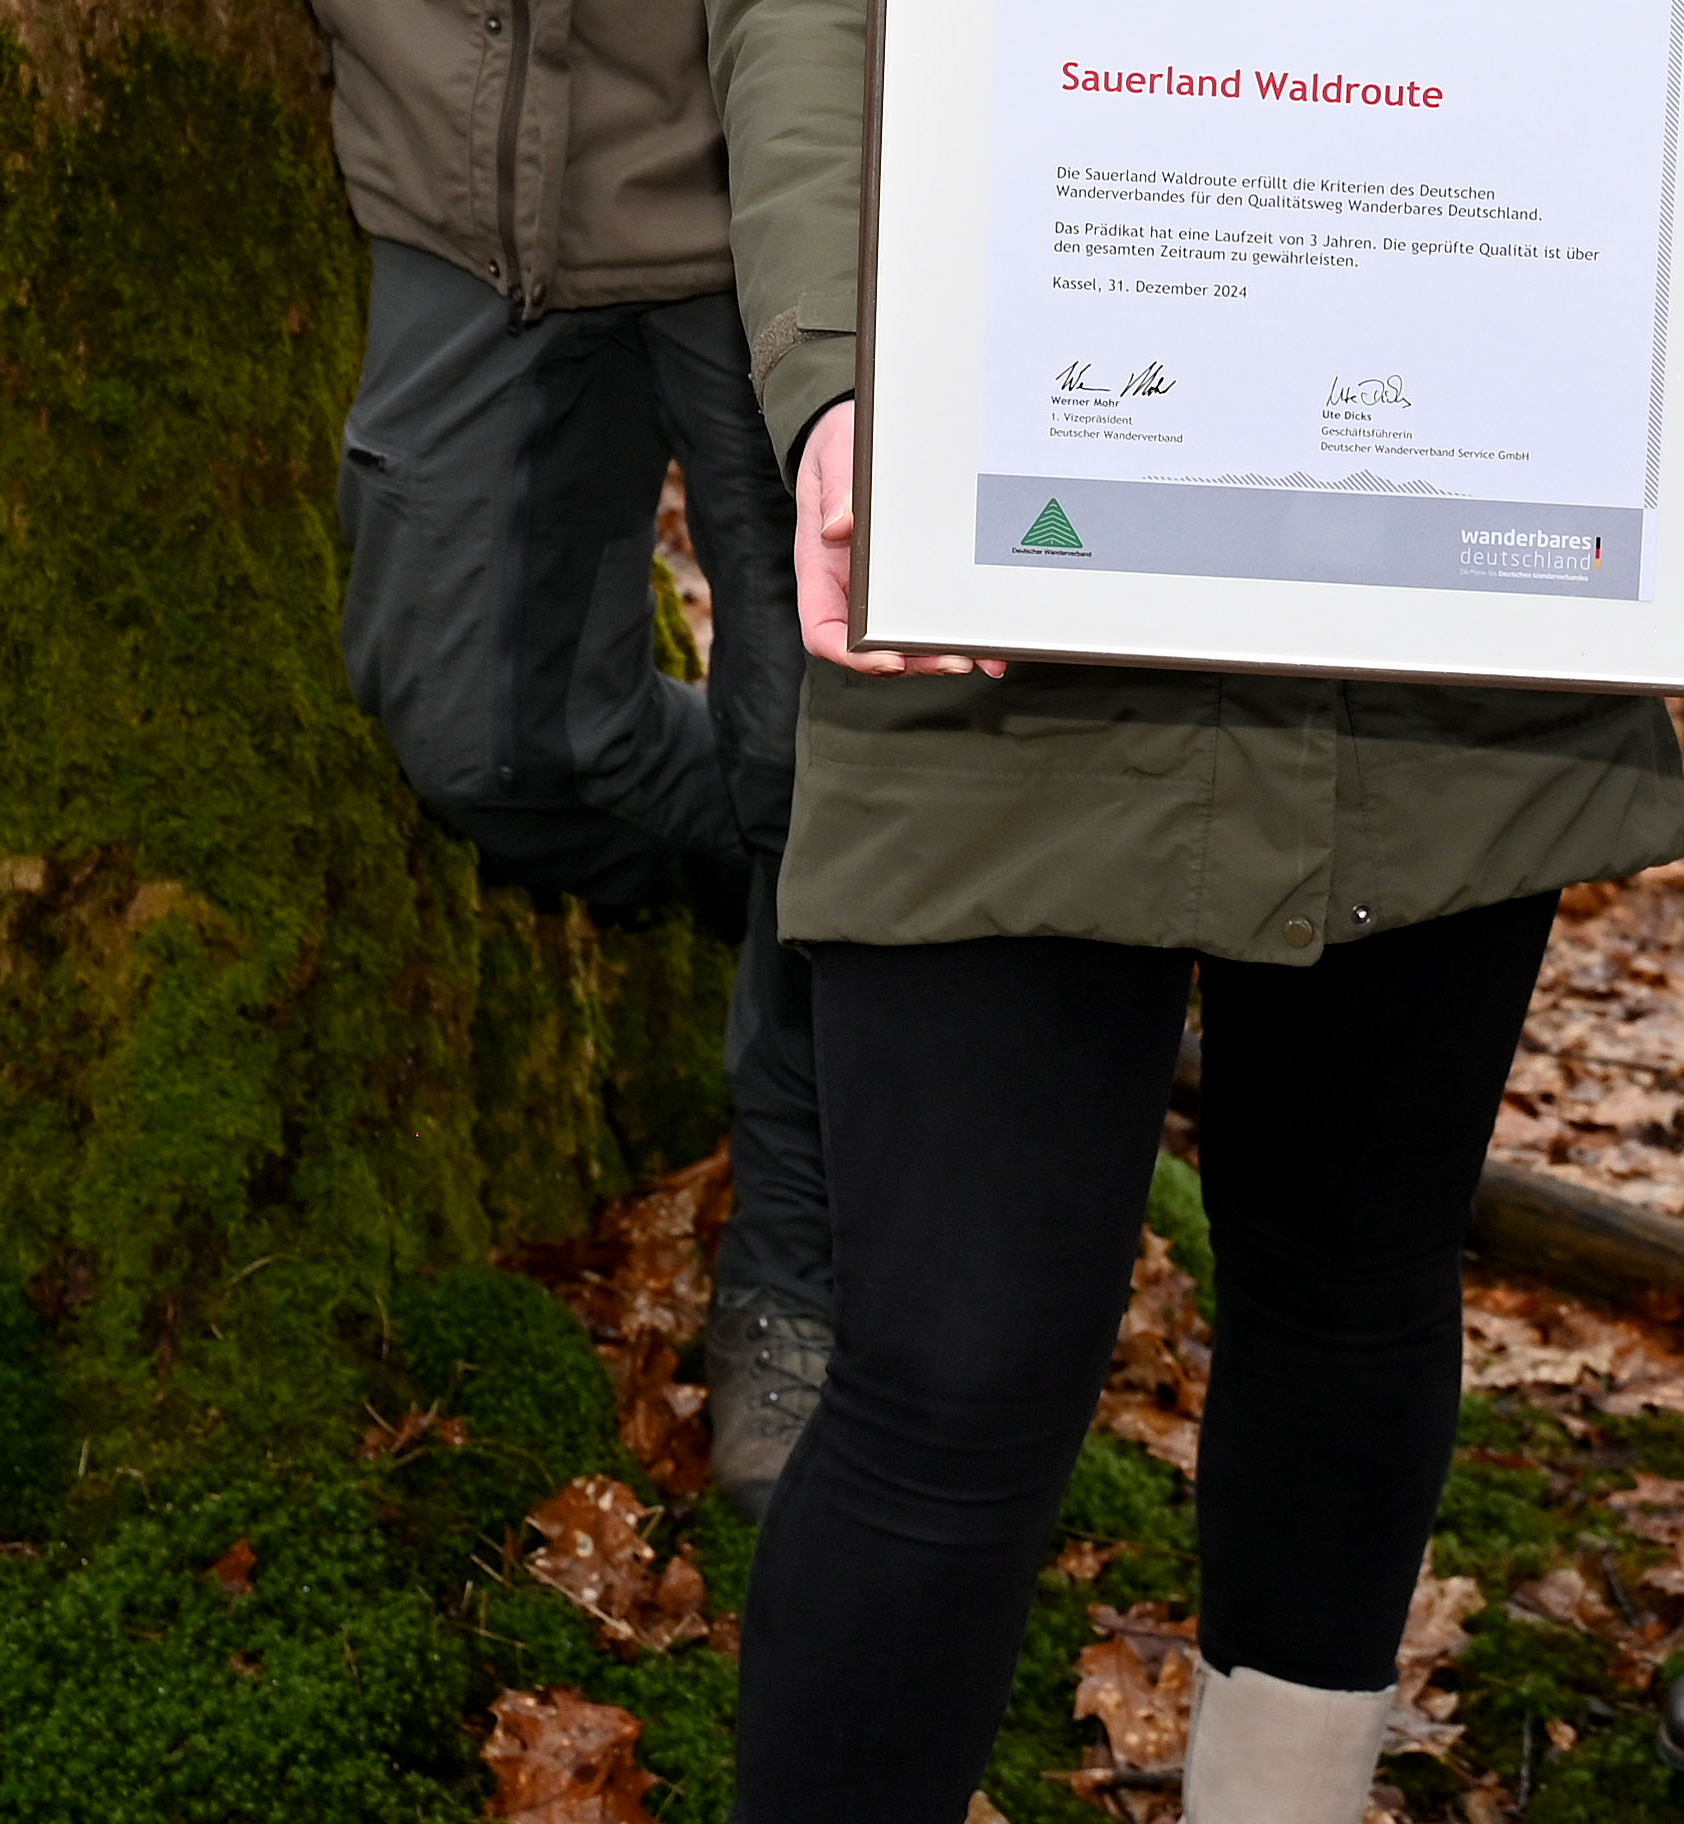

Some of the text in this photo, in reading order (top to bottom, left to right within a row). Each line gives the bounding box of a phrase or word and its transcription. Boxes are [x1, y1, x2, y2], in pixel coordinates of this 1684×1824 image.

[1061, 61, 1443, 109] Sauerland Waldroute
[1057, 166, 1495, 201] Die Sauerland Waldroute erfüllt die Kriterien des Deutschen
[1056, 184, 1542, 222] Wanderverbandes für den Qualitätsweg Wanderbares Deutschland.
[1055, 221, 1600, 261] Das Prädikat hat eine Laufzeit von 3 Jahren. Die geprüfte Qualität ist über
[1053, 239, 1358, 268] den gesamten Zeitraum zu gewährleisten.
[1052, 276, 1247, 299] Kassel, 31. Dezember 2024
[1050, 395, 1120, 408] Werner Mohr
[1051, 412, 1133, 426] 1. Vizepräsident
[1322, 409, 1372, 421] Ute Dicks
[1049, 427, 1183, 443] Deutscher Wanderverband
[1321, 425, 1413, 440] Geschäftsführerin
[1320, 441, 1530, 462] Deutscher Wanderverband Service GmbH
[1461, 528, 1592, 550] wanderbares
[1460, 547, 1591, 571] deutschland
